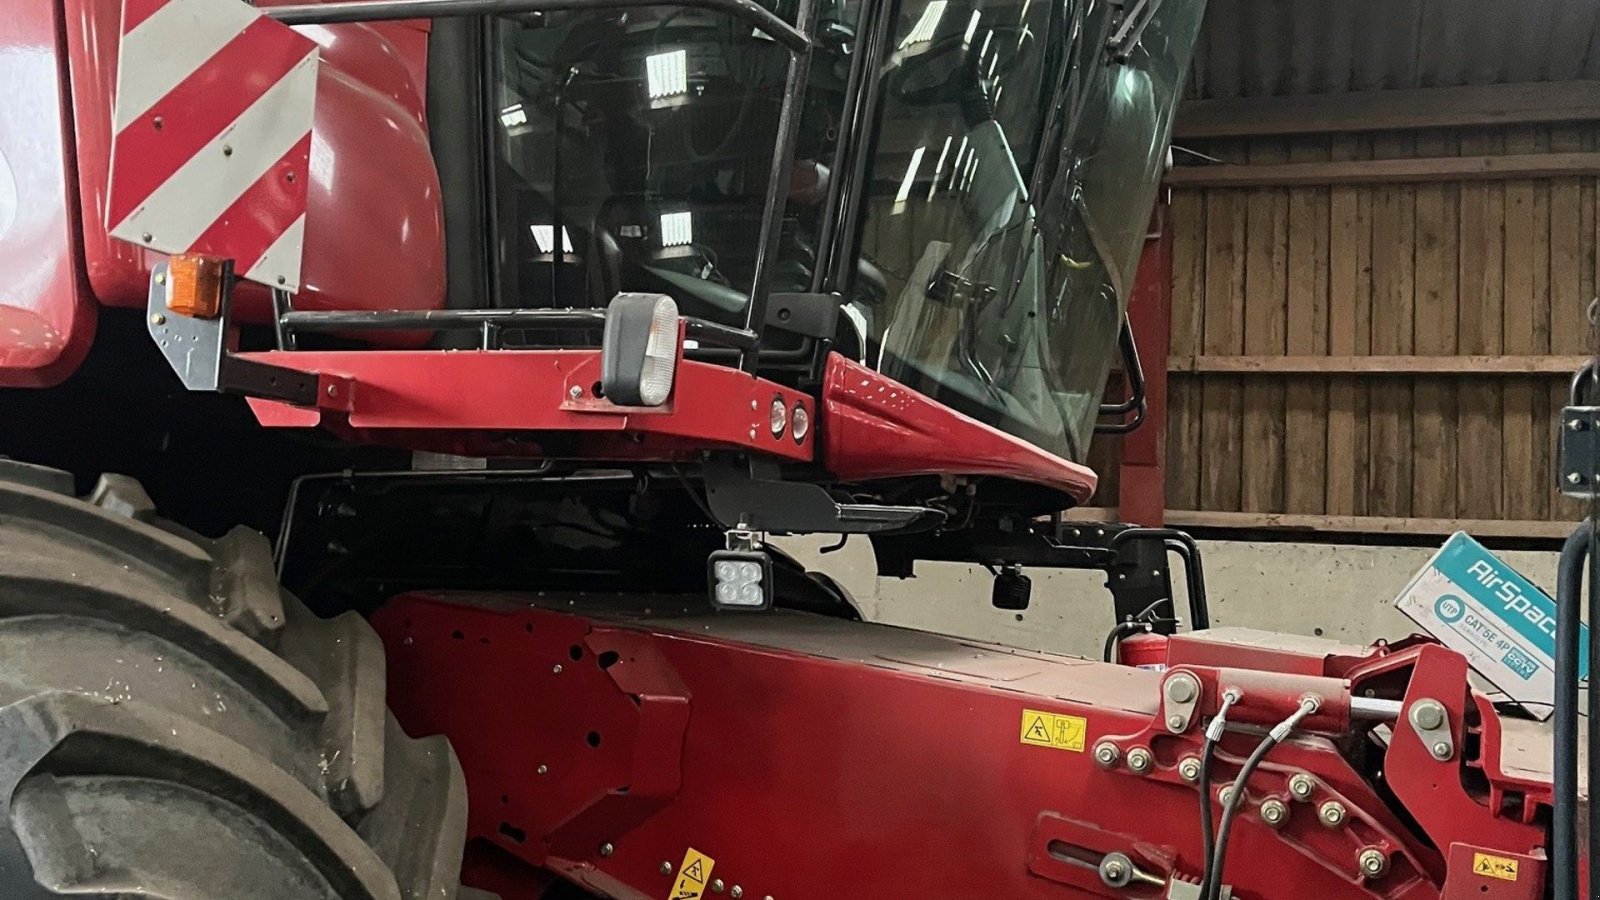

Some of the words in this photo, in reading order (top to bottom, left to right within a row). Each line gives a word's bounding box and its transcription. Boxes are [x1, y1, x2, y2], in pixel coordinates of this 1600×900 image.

[1442, 601, 1458, 615] UTP
[1467, 560, 1556, 640] AirSpac
[1496, 639, 1511, 651] 4P
[1507, 652, 1533, 673] CCTV
